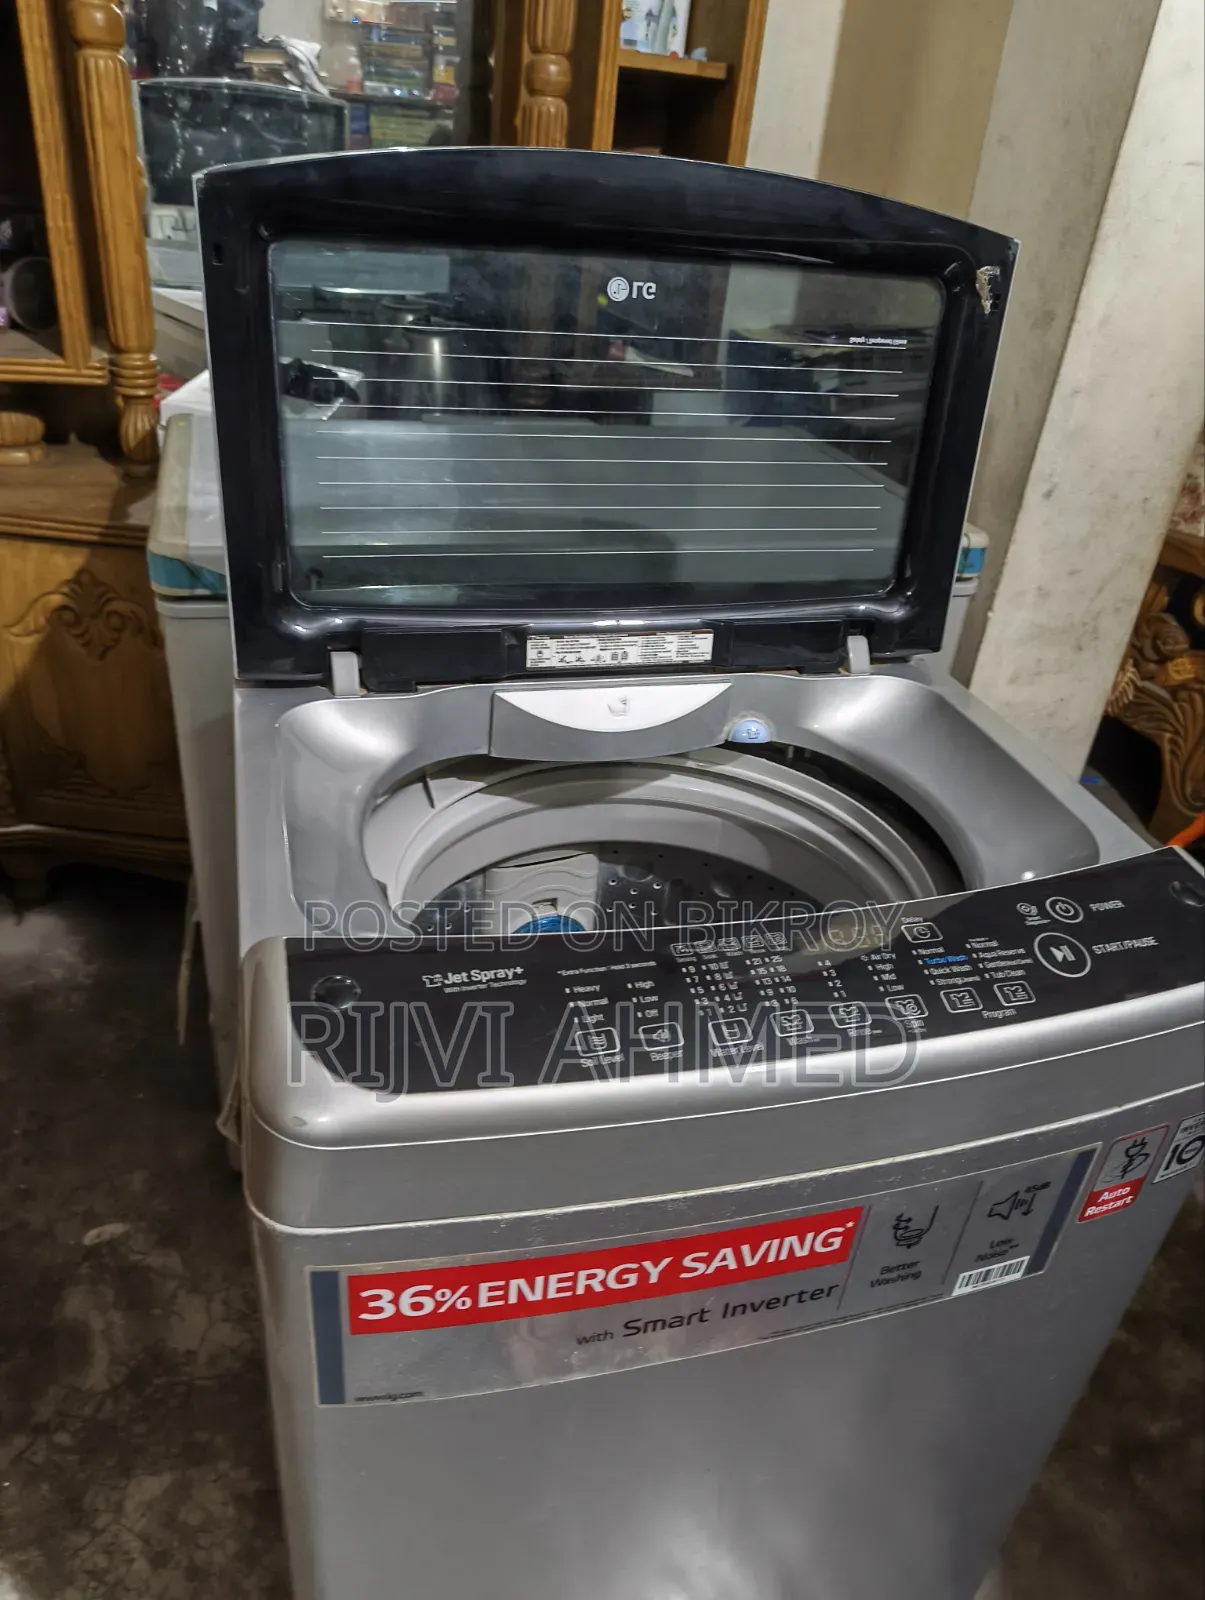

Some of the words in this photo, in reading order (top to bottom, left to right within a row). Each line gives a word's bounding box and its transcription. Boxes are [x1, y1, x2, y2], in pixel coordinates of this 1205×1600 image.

[1089, 899, 1126, 911] POWER
[1092, 936, 1159, 954] START/PAUSE
[444, 972, 469, 985] Jet
[470, 966, 525, 982] Spray+
[1097, 1186, 1132, 1203] Auto
[1084, 1195, 1135, 1217] Restart
[879, 1260, 921, 1276] Better
[869, 1270, 922, 1288] Washing
[357, 1284, 473, 1321] 36%
[477, 1256, 673, 1309] ENERGY
[576, 1329, 615, 1346] with
[623, 1308, 711, 1338] Smart
[722, 1284, 839, 1319] Inverter
